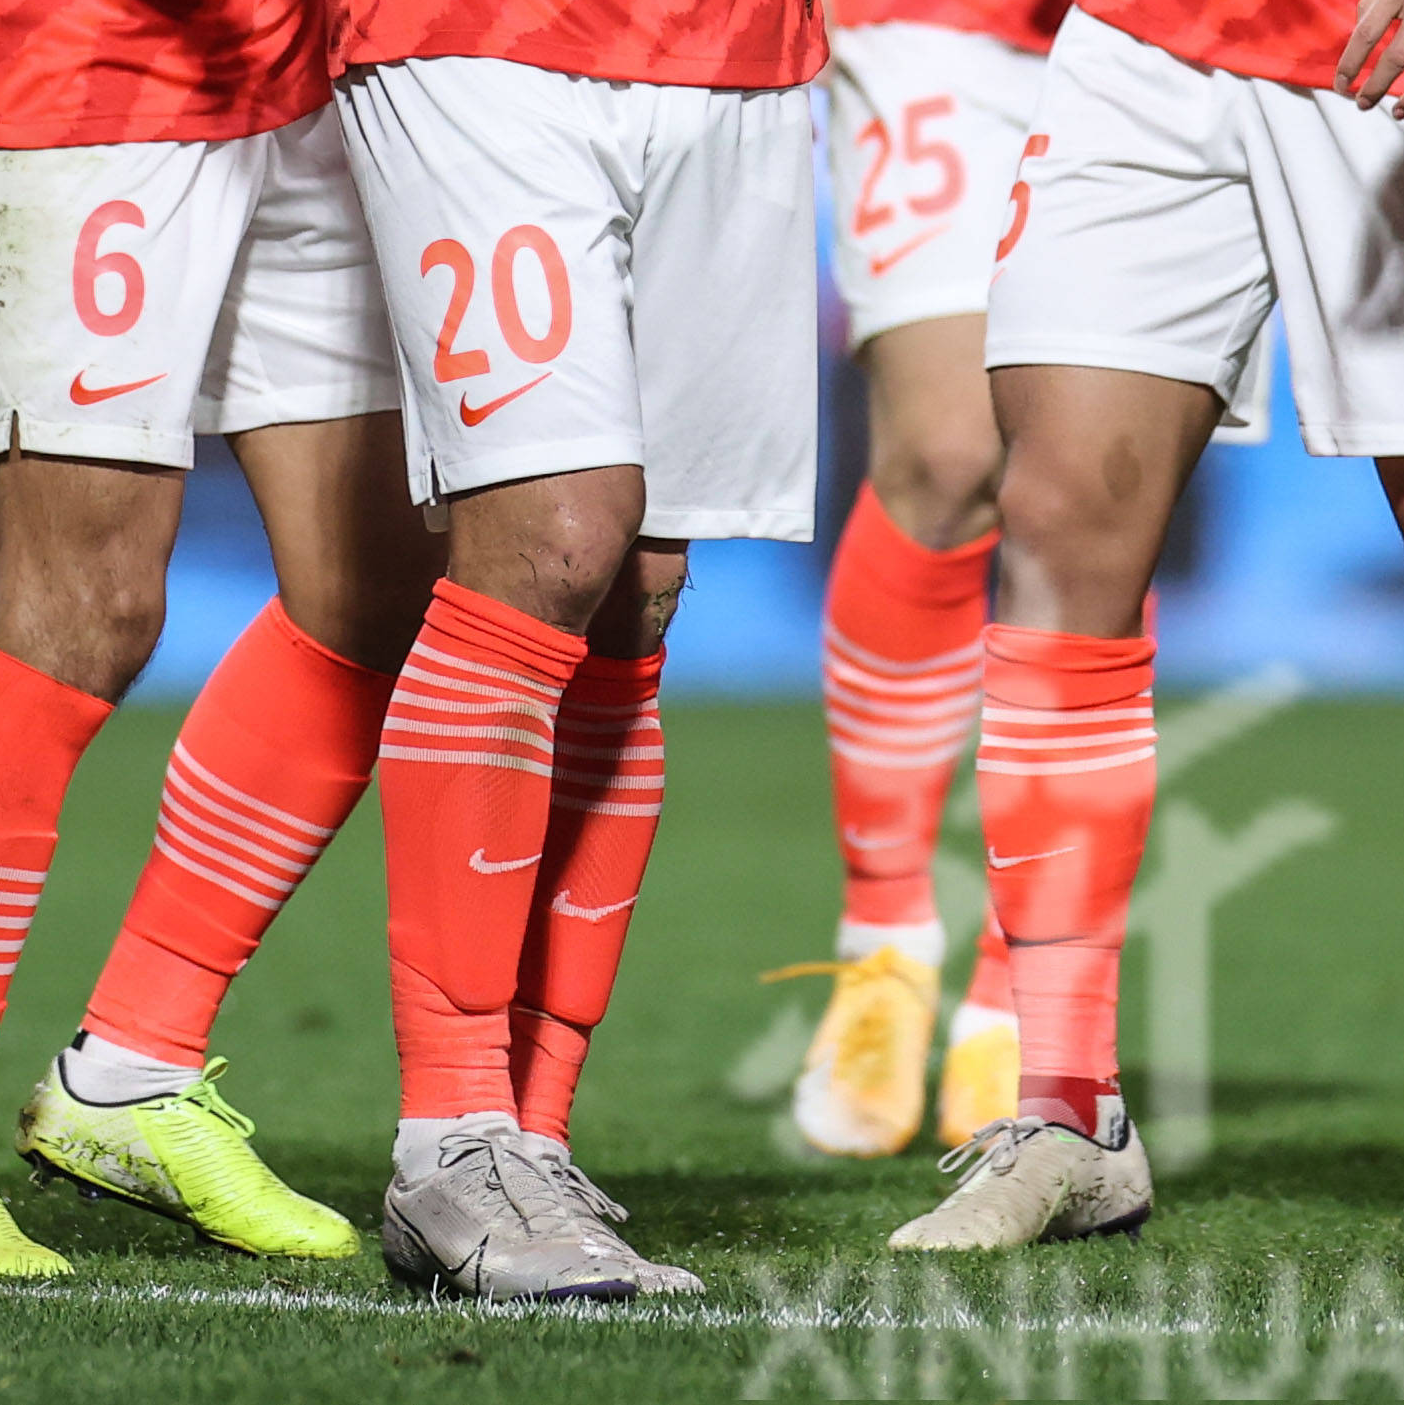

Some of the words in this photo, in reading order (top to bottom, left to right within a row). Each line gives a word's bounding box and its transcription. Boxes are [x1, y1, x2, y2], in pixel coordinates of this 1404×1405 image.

[852, 95, 965, 239] 25
[73, 200, 146, 337] 6
[419, 224, 572, 384] 20
